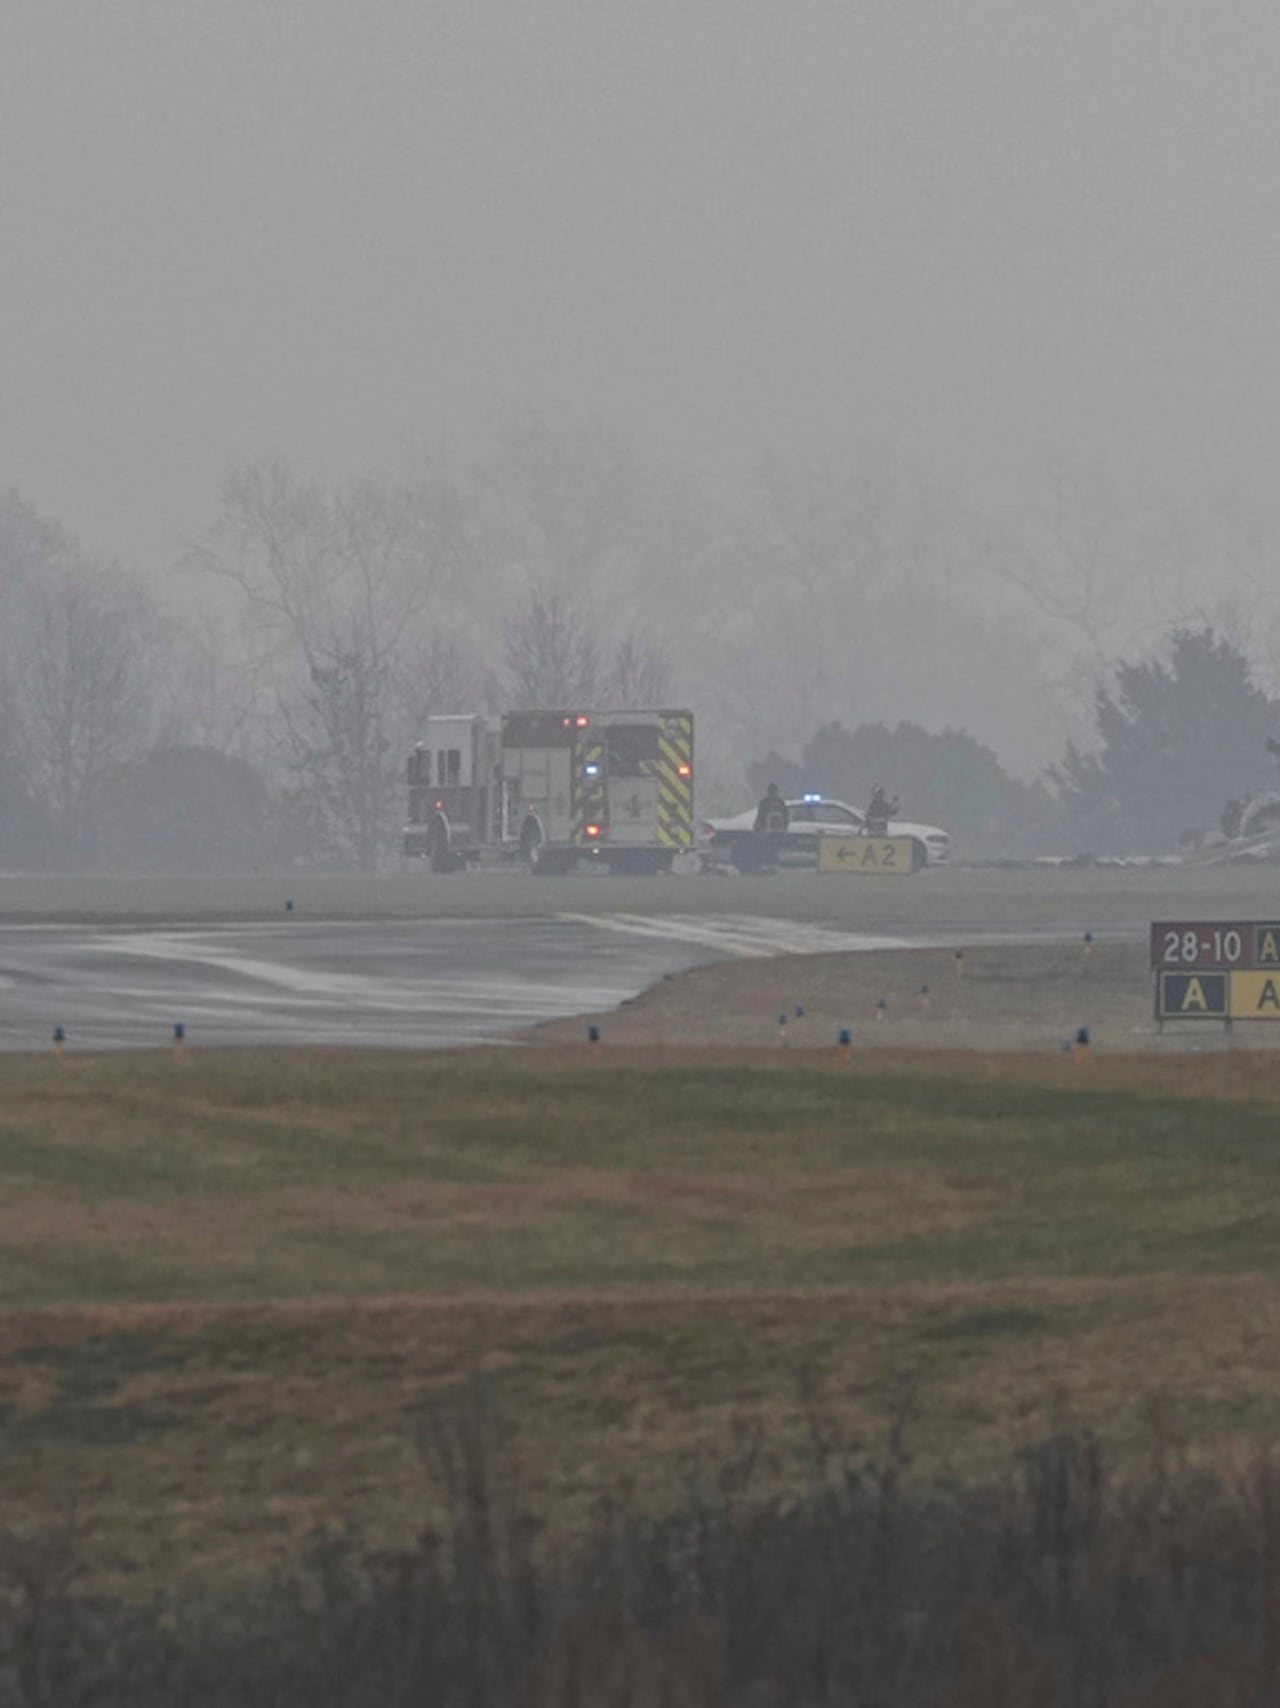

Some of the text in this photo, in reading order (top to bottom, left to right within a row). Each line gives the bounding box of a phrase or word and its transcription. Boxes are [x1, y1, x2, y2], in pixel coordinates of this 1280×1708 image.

[861, 844, 897, 866] A2
[1164, 931, 1241, 962] 28-10
[1182, 977, 1207, 1010] A
